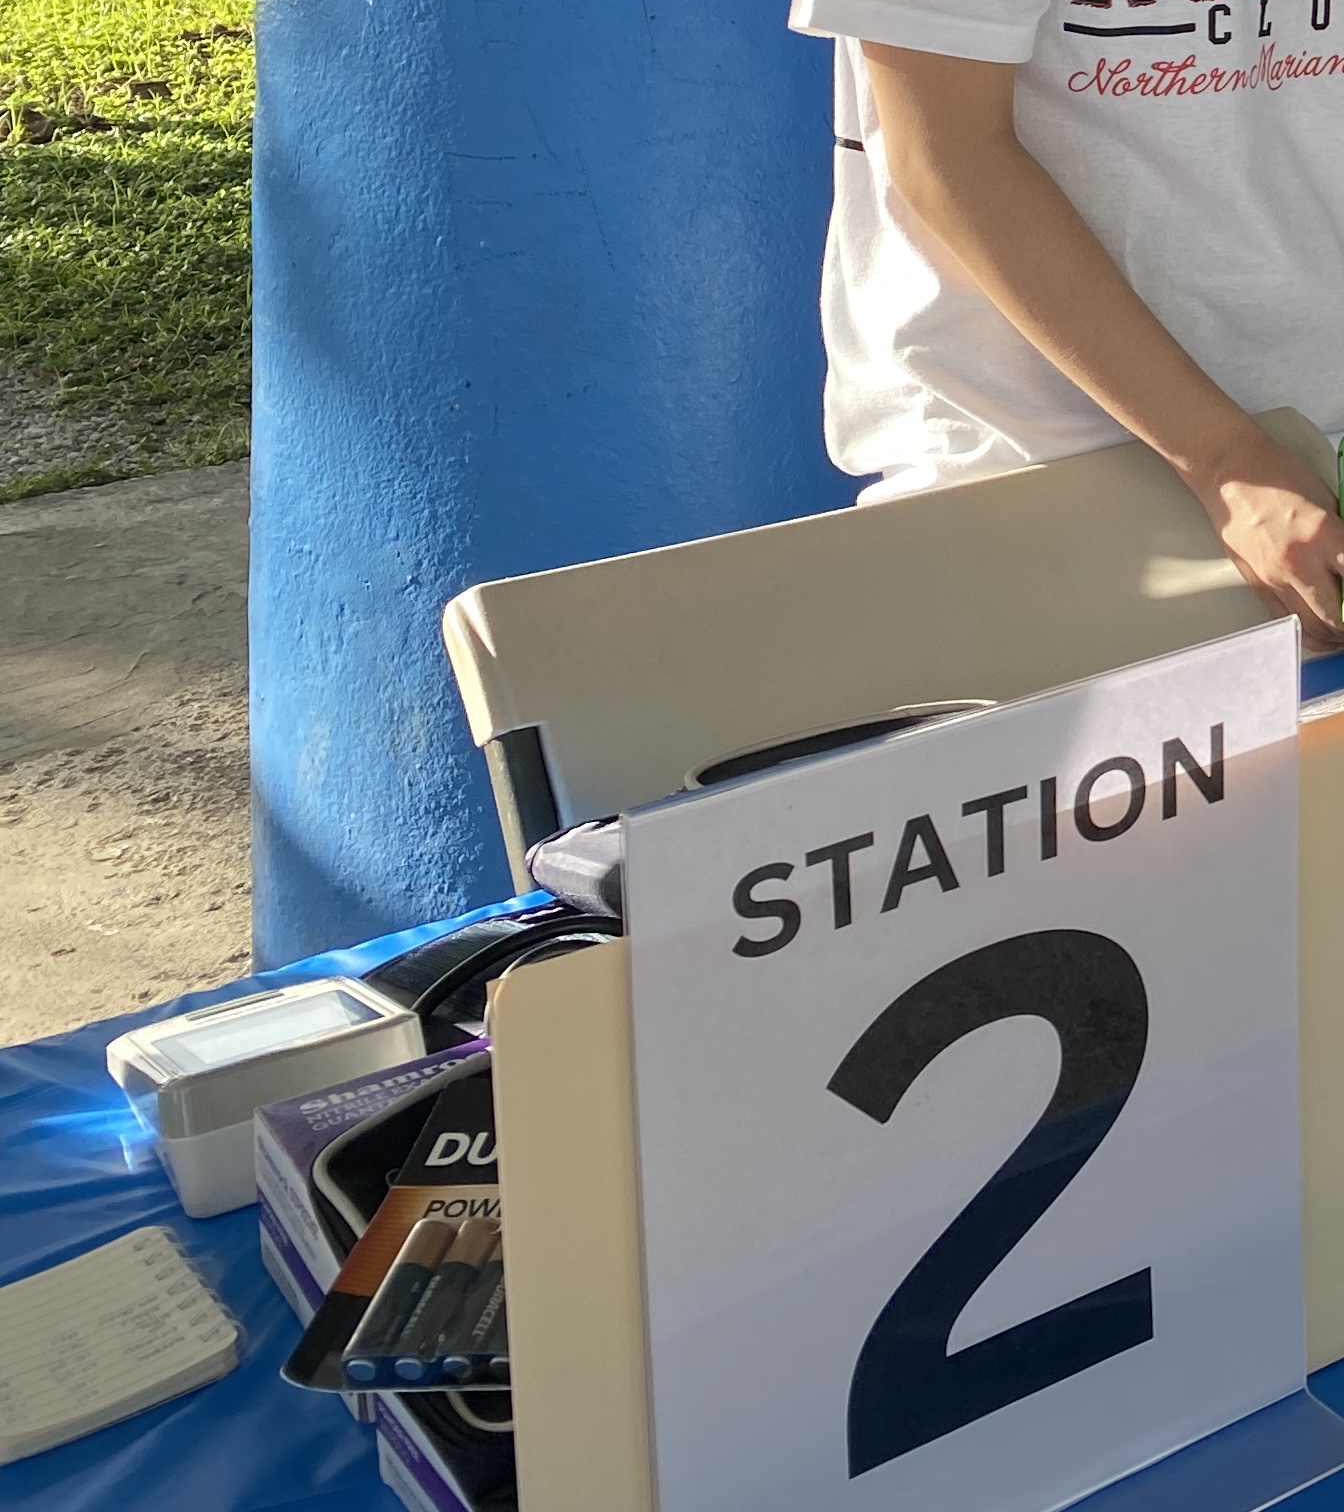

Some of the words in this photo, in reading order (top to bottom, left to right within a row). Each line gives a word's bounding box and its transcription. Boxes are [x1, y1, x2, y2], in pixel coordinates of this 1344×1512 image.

[1067, 53, 1248, 98] Northern
[731, 723, 1227, 959] STATION
[307, 1090, 386, 1124] NITRILE
[826, 928, 1154, 1479] 2
